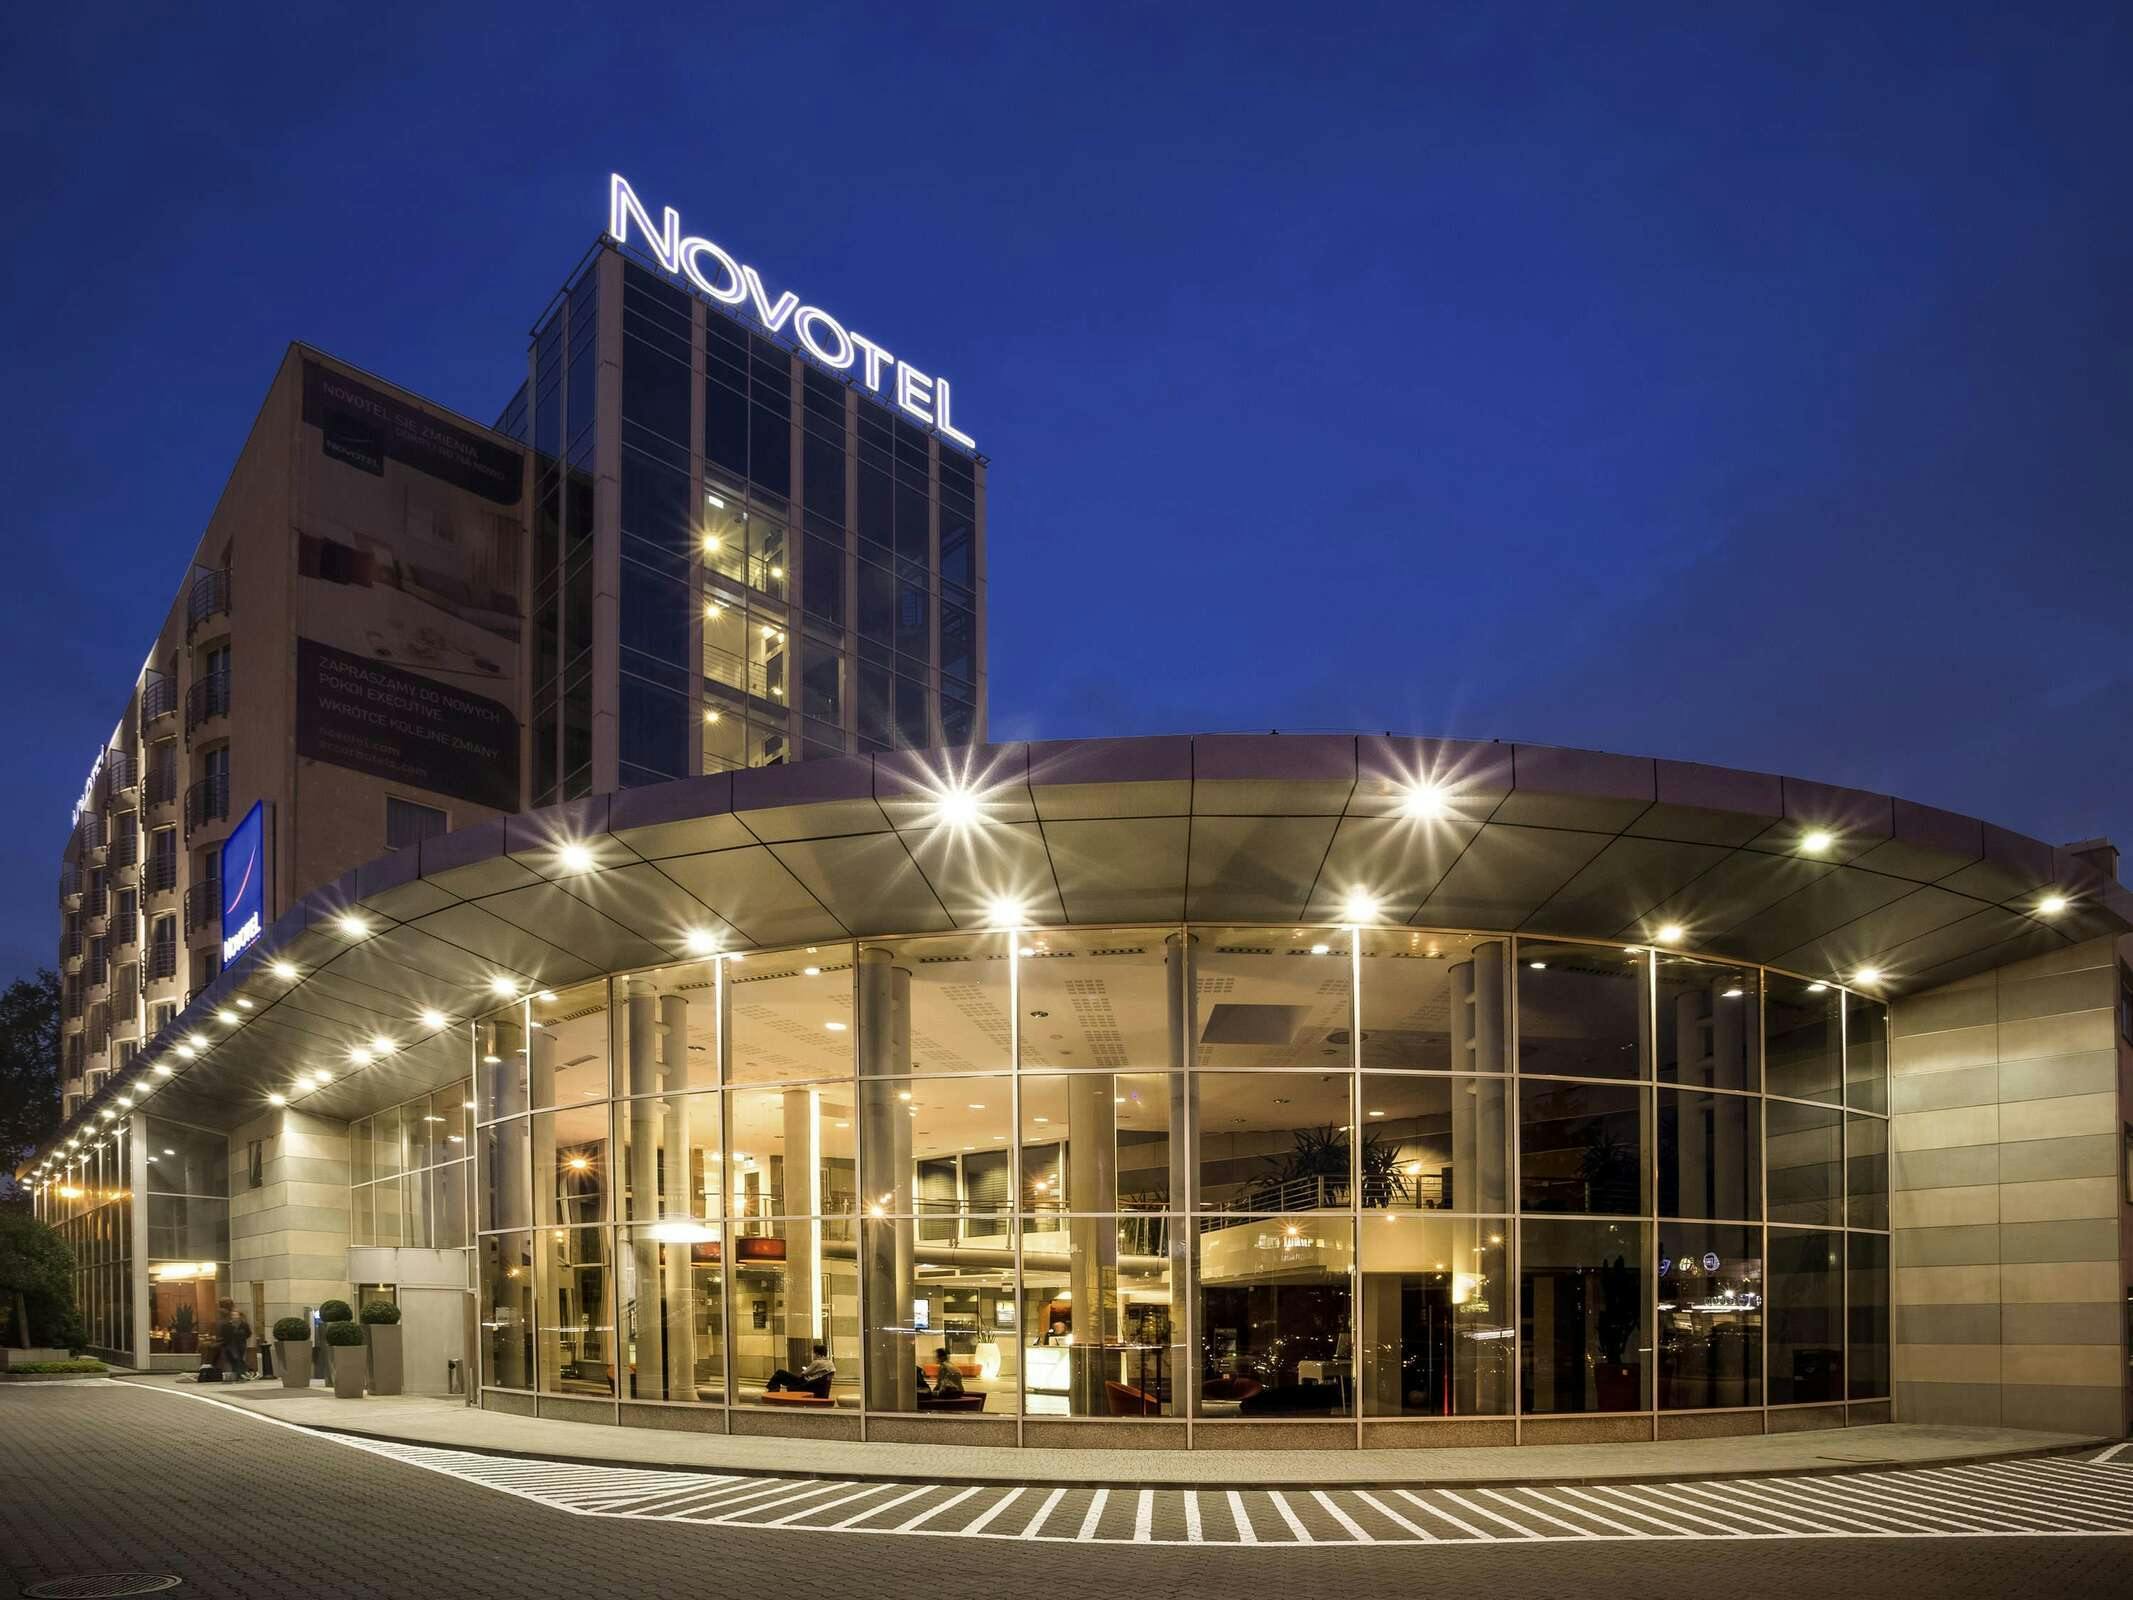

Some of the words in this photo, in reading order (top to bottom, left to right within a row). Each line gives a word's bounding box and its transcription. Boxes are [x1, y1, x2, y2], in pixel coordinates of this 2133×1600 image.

[610, 173, 976, 449] NOVOTEL
[323, 381, 388, 418] NOVOTEL
[319, 656, 417, 697] ZAPRASZAMY
[419, 687, 441, 704] DO
[442, 697, 501, 723] NOWYCH
[319, 673, 364, 697] POKOI
[368, 689, 442, 721] EXECUTIVE
